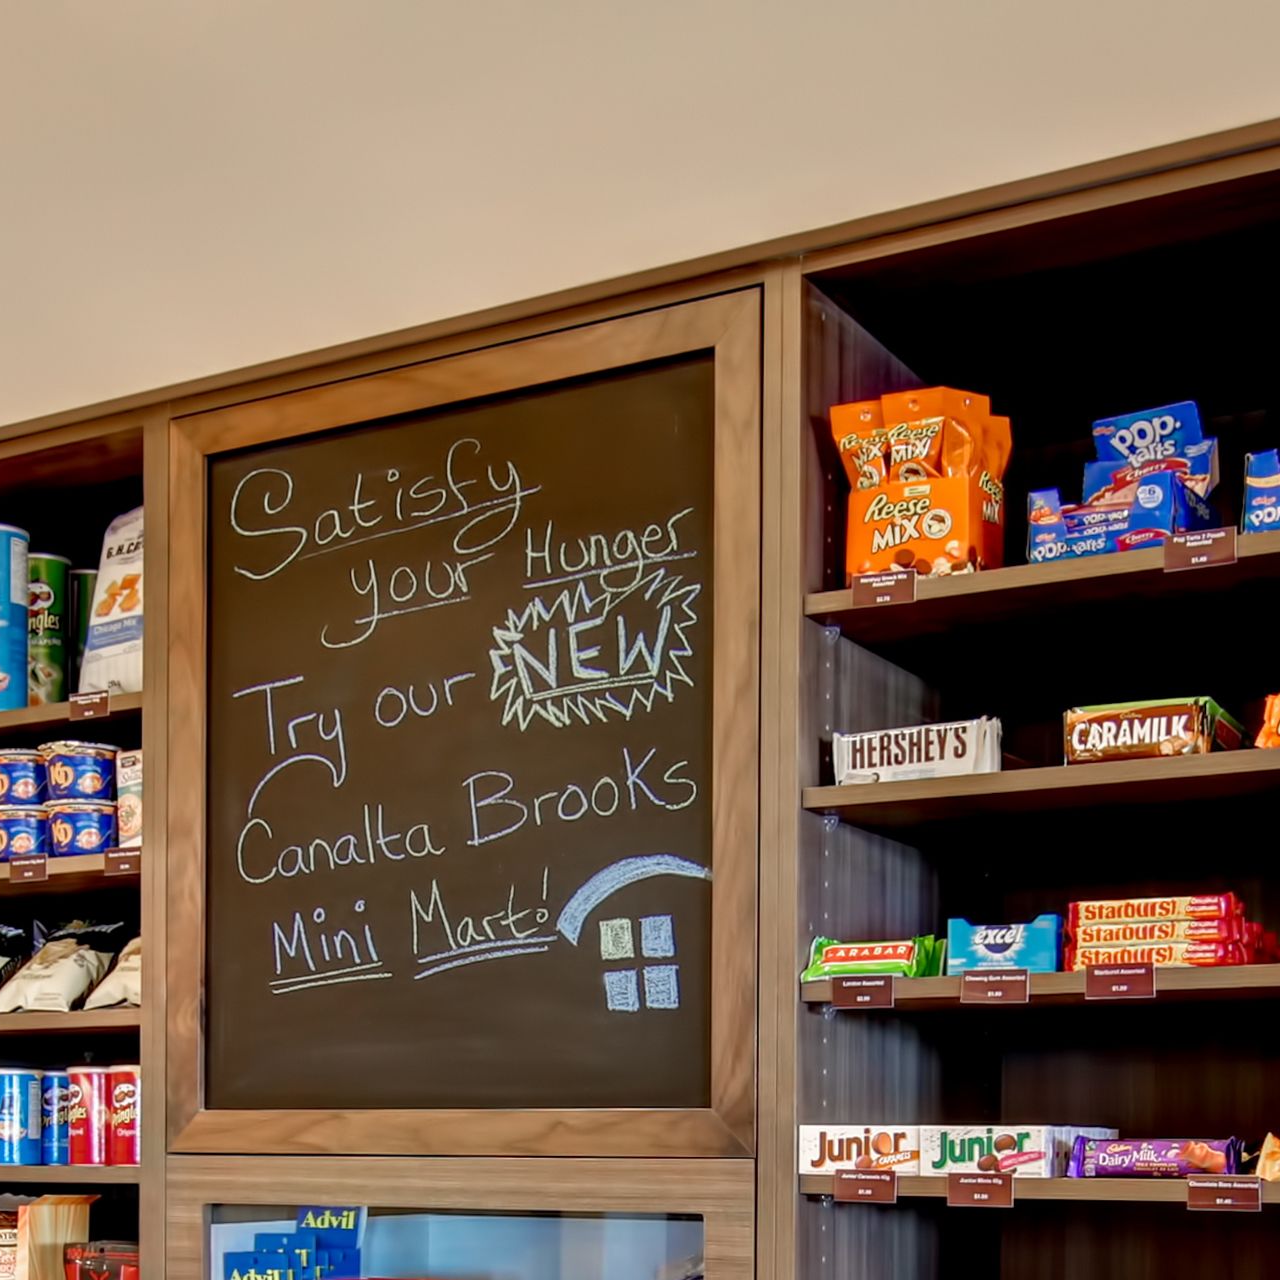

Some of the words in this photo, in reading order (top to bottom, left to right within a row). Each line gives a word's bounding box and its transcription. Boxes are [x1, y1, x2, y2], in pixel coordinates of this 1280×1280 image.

[887, 423, 939, 442] Reese
[1125, 463, 1167, 482] Cherry
[230, 438, 522, 580] Satisfy
[864, 494, 930, 523] Reese
[321, 553, 495, 648] your
[526, 507, 694, 593] Hunger
[513, 605, 672, 699] NEW
[233, 675, 346, 790] Try
[375, 672, 477, 727] our
[851, 725, 967, 769] HERSHEY'S
[1072, 715, 1190, 750] CARAMILK
[237, 803, 446, 883] Canalta
[272, 900, 381, 974] Mini
[411, 866, 550, 955] Mart!
[974, 925, 1023, 945] excel
[1099, 1153, 1131, 1168] Dairy
[1132, 1150, 1158, 1162] Milk
[300, 1209, 357, 1230] Advil
